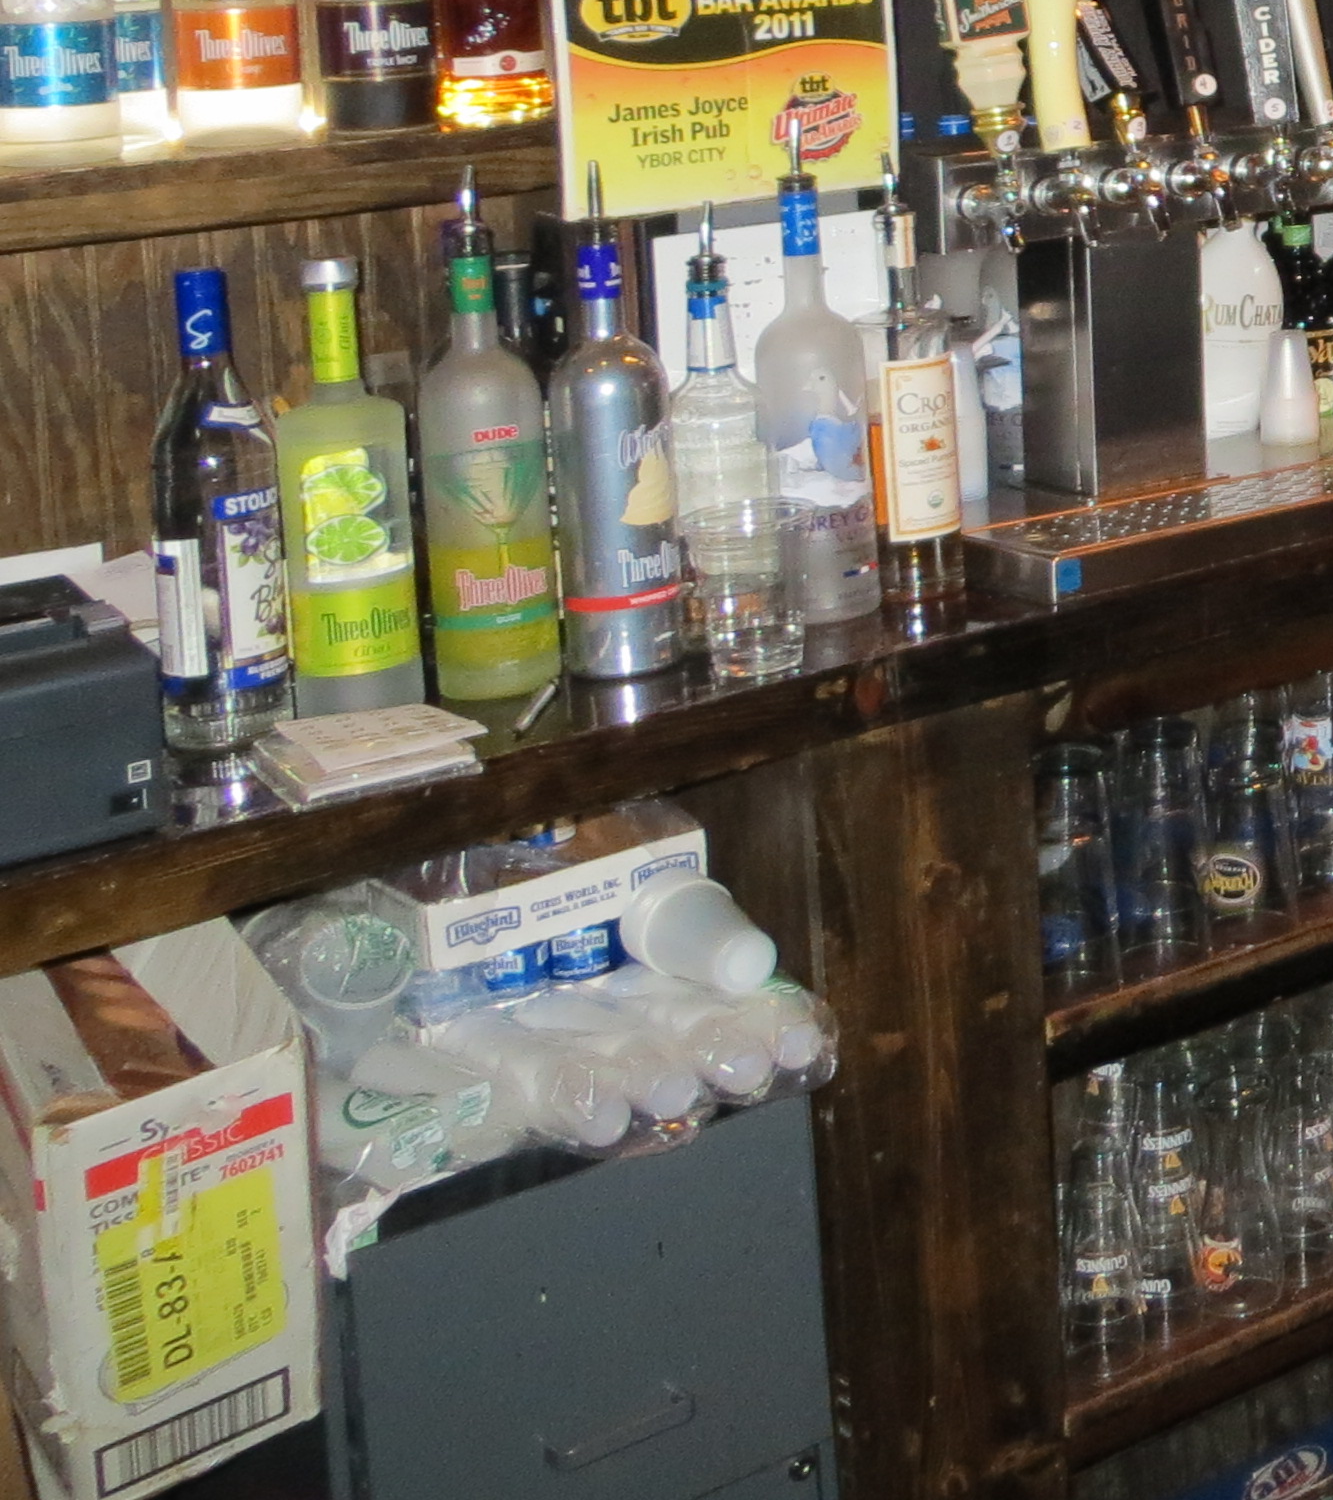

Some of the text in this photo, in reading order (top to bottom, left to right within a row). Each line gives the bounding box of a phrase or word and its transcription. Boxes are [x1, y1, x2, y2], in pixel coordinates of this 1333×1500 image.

[754, 11, 815, 41] 2011
[1253, 5, 1280, 85] CIDER
[799, 76, 829, 93] tbt
[608, 95, 748, 124] James Joyce
[631, 119, 730, 147] Irish Pub
[637, 147, 726, 169] YBOR CITY
[321, 611, 370, 647] Three
[454, 909, 519, 940] Bluebird
[555, 929, 607, 952] Bluebird
[219, 1143, 285, 1181] 7602741
